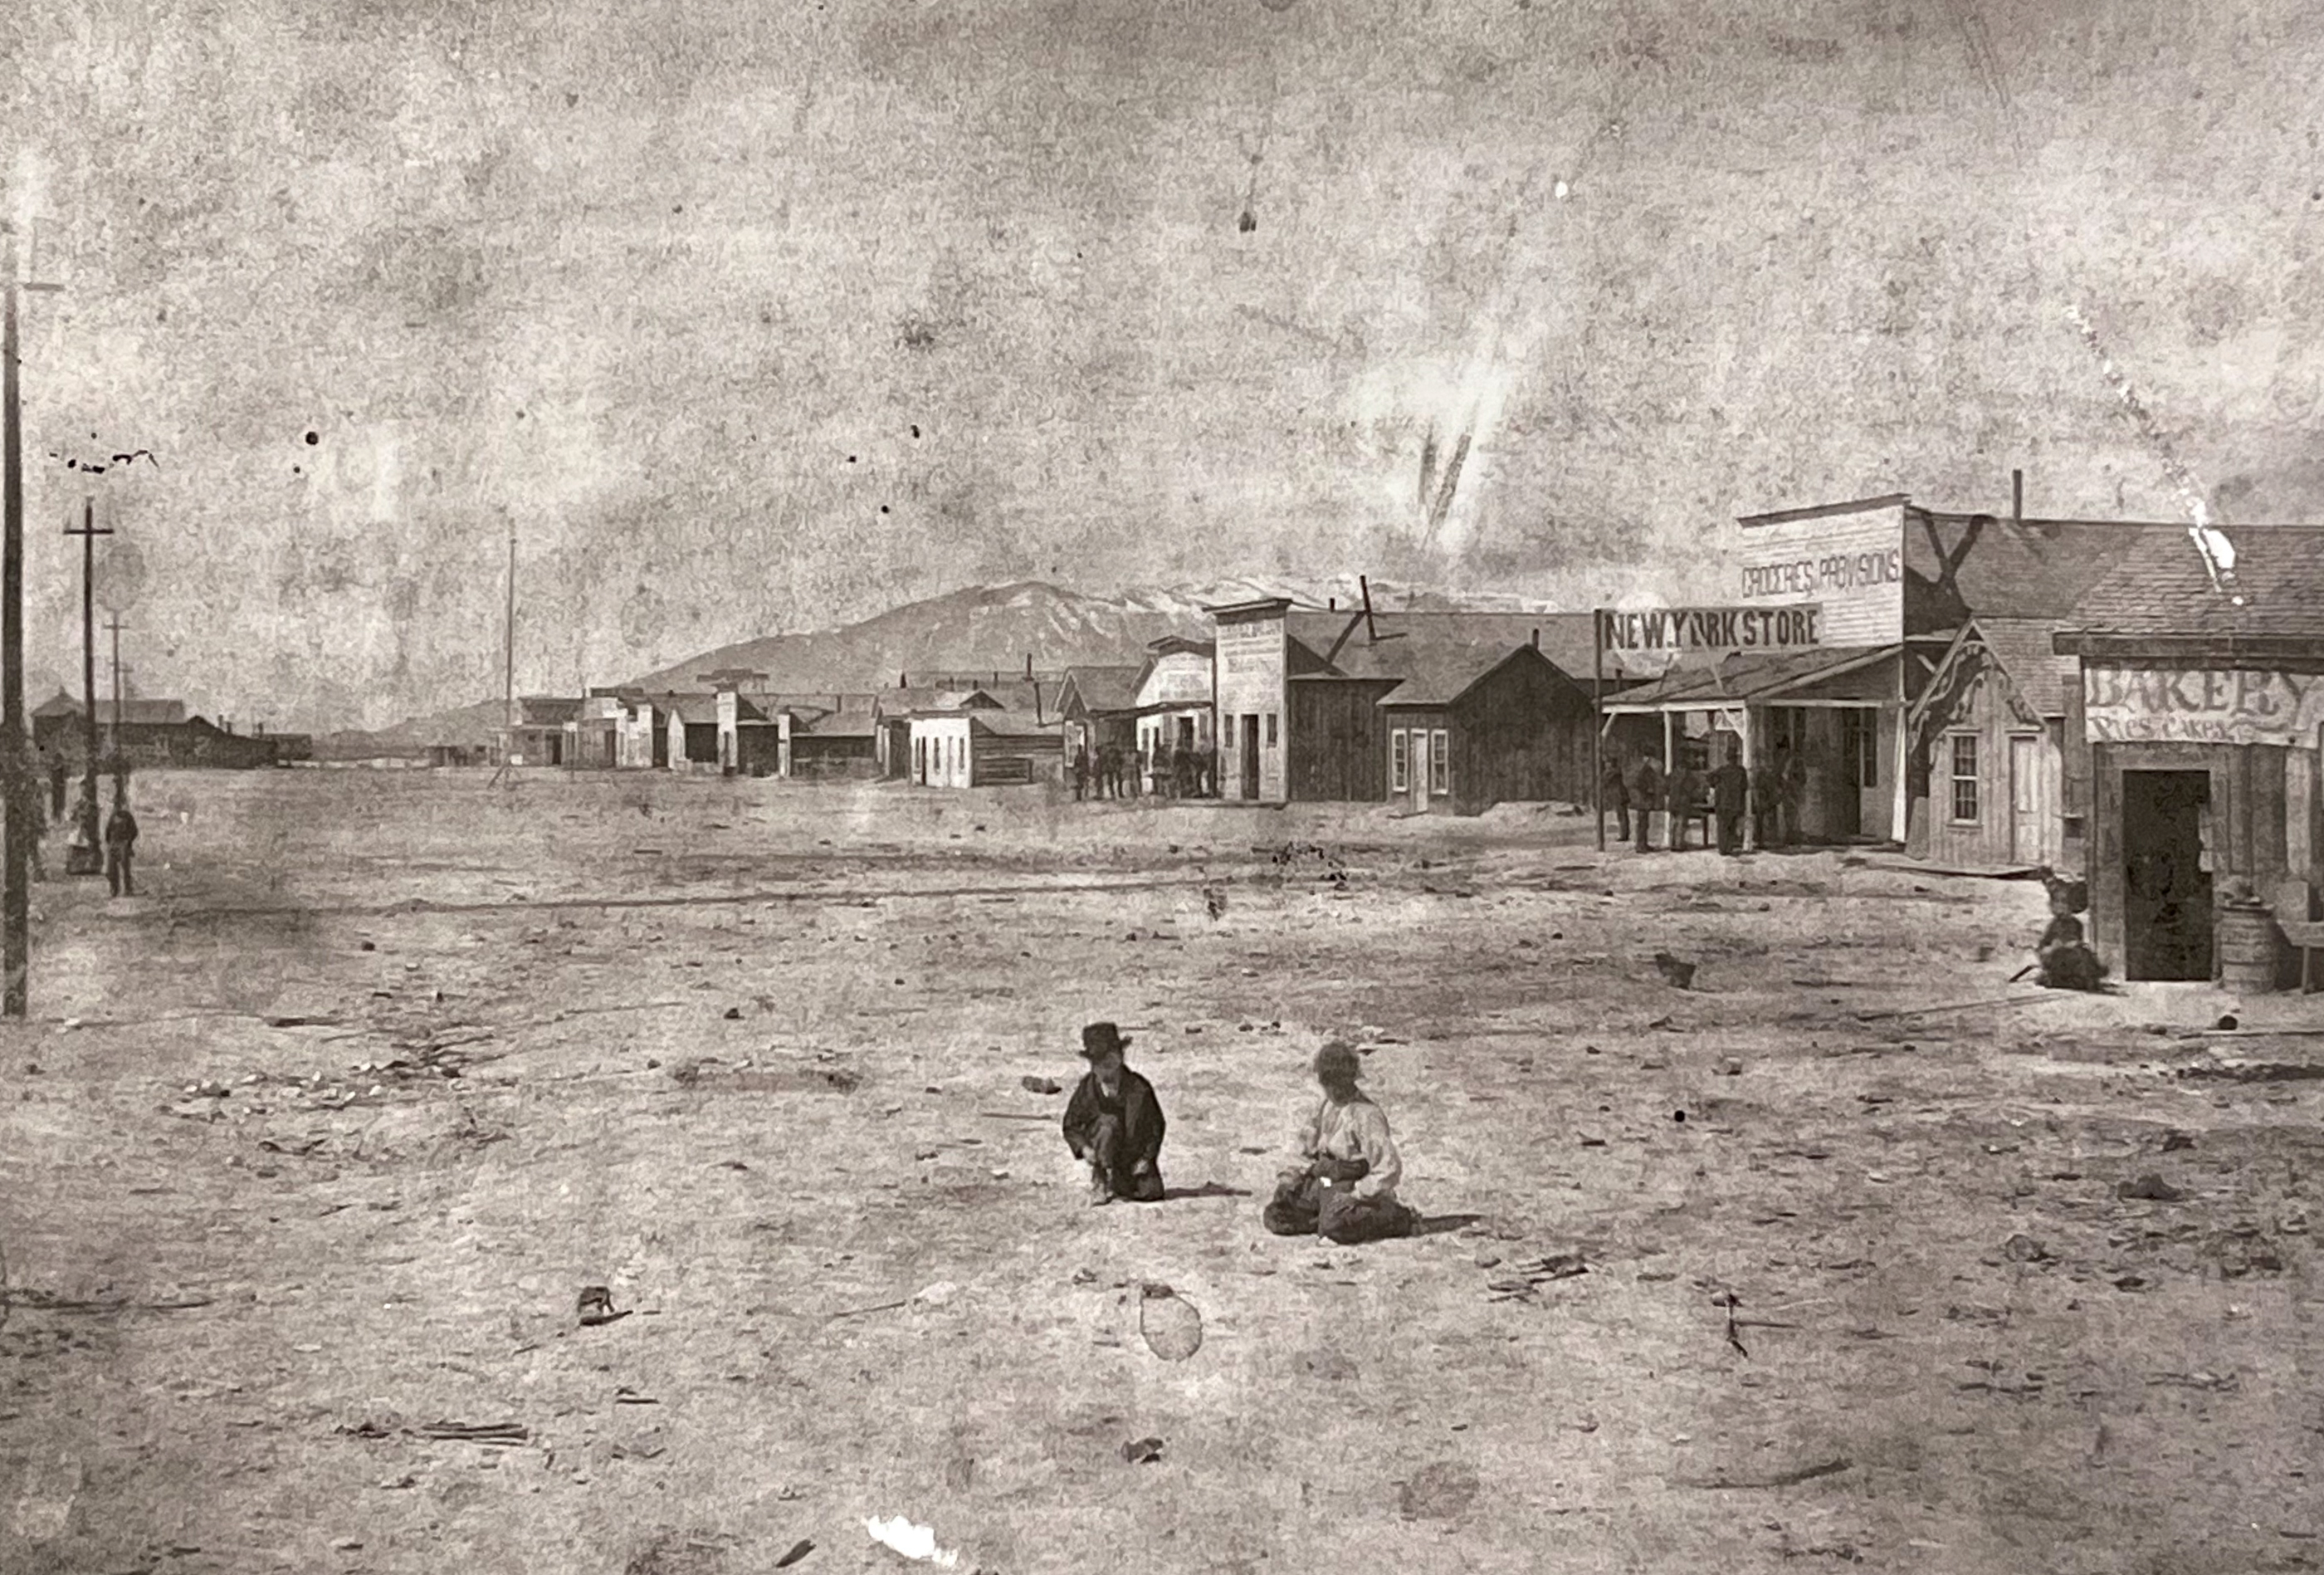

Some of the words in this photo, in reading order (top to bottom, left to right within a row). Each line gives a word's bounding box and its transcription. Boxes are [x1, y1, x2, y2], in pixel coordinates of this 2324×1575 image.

[1604, 613, 1666, 650] NEW
[1668, 611, 1740, 648] YORK
[1742, 609, 1820, 647] STORE
[2083, 668, 2319, 727] BAKERY
